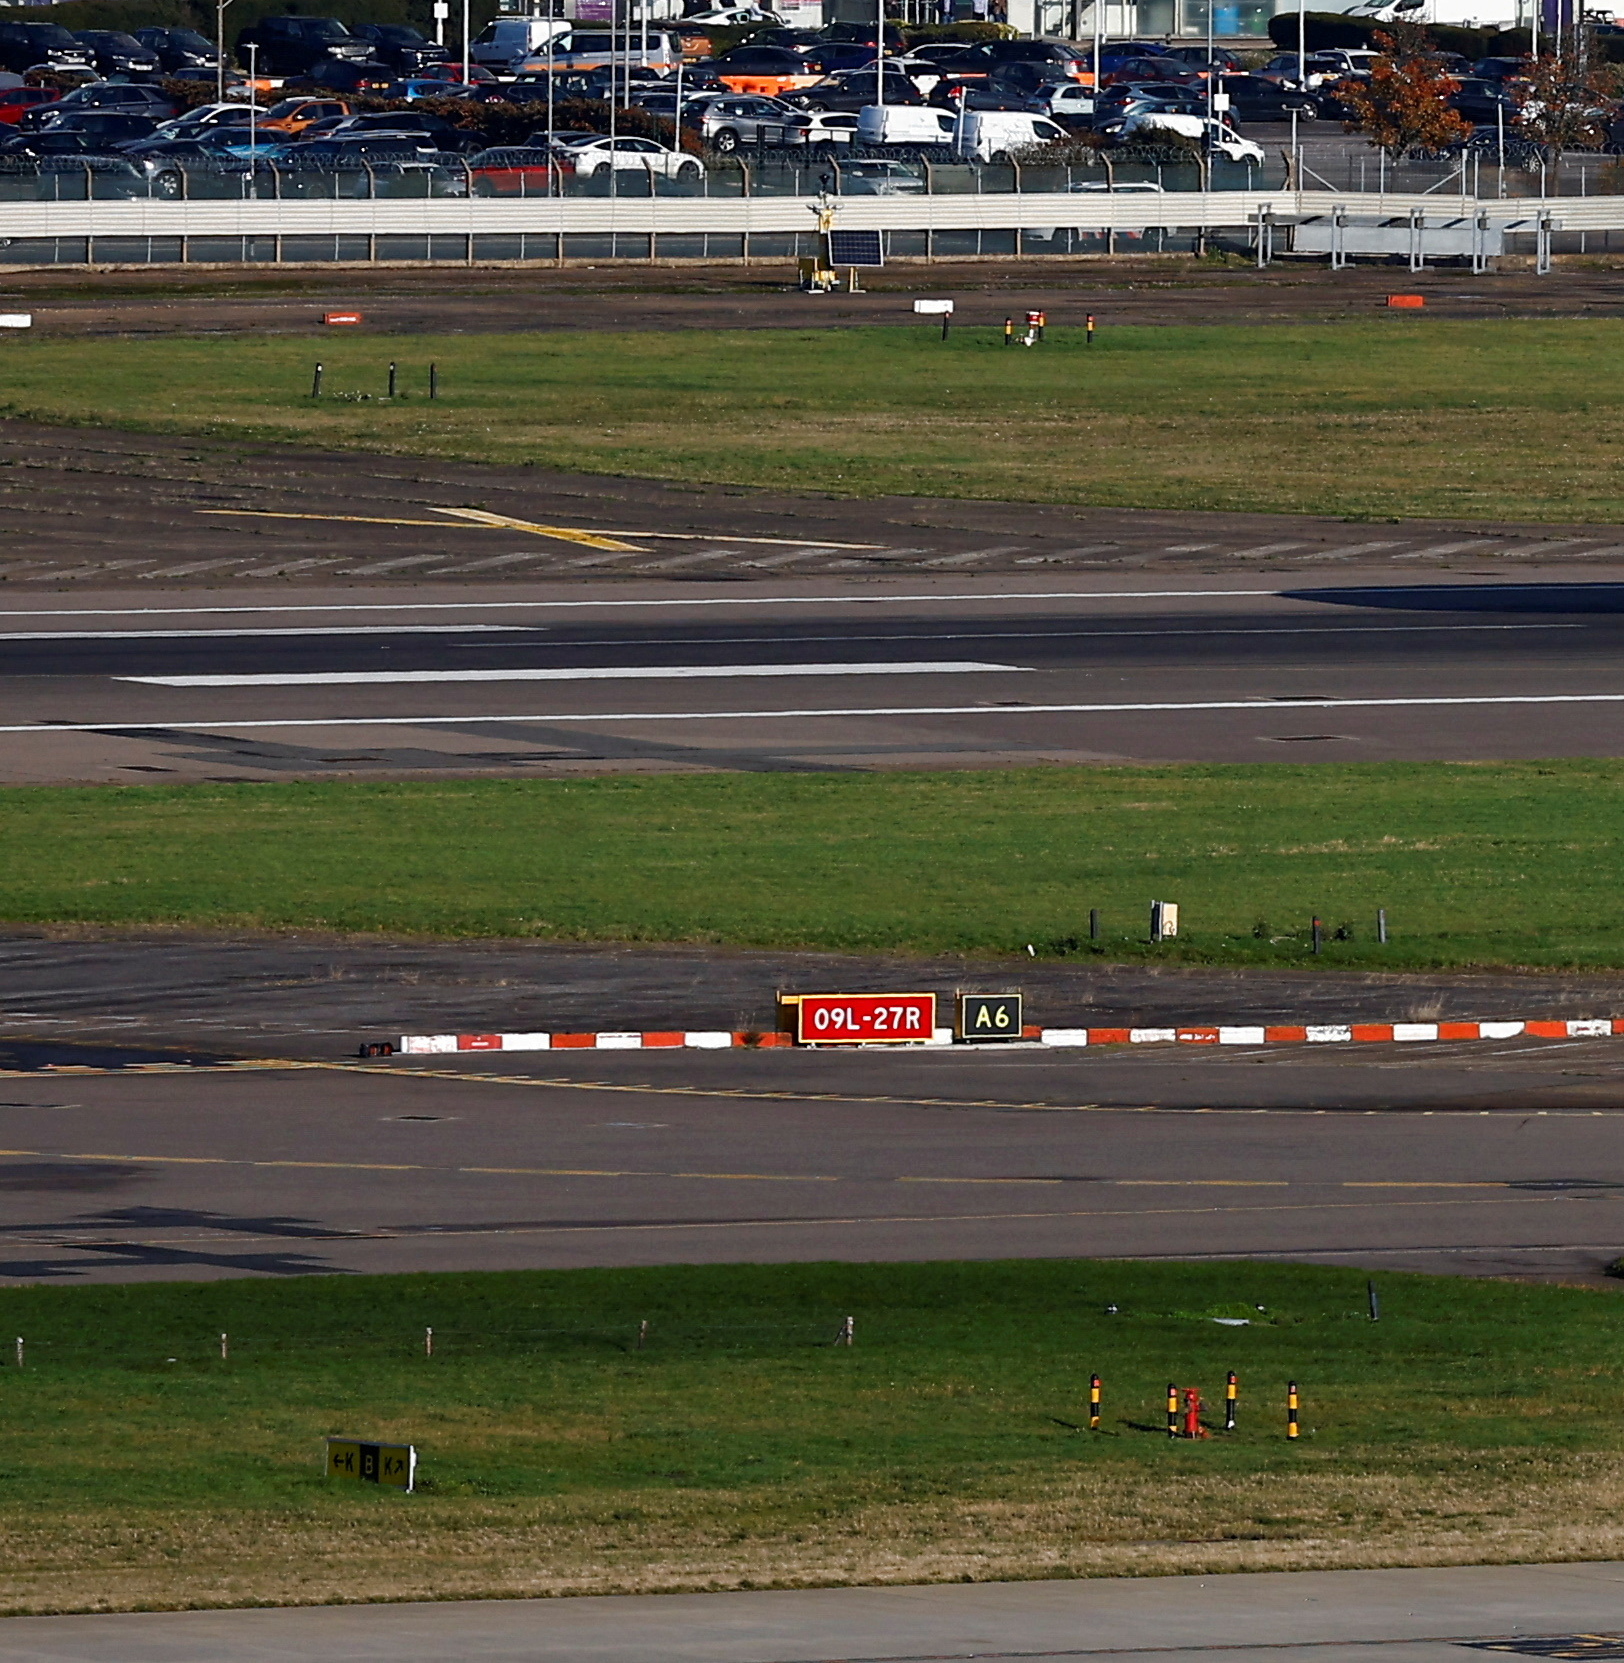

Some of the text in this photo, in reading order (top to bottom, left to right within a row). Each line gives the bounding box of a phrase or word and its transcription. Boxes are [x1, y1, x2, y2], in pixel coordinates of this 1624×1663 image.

[814, 1006, 921, 1030] 09L-27R
[975, 1004, 1010, 1029] A6
[345, 1452, 392, 1476] K B K
